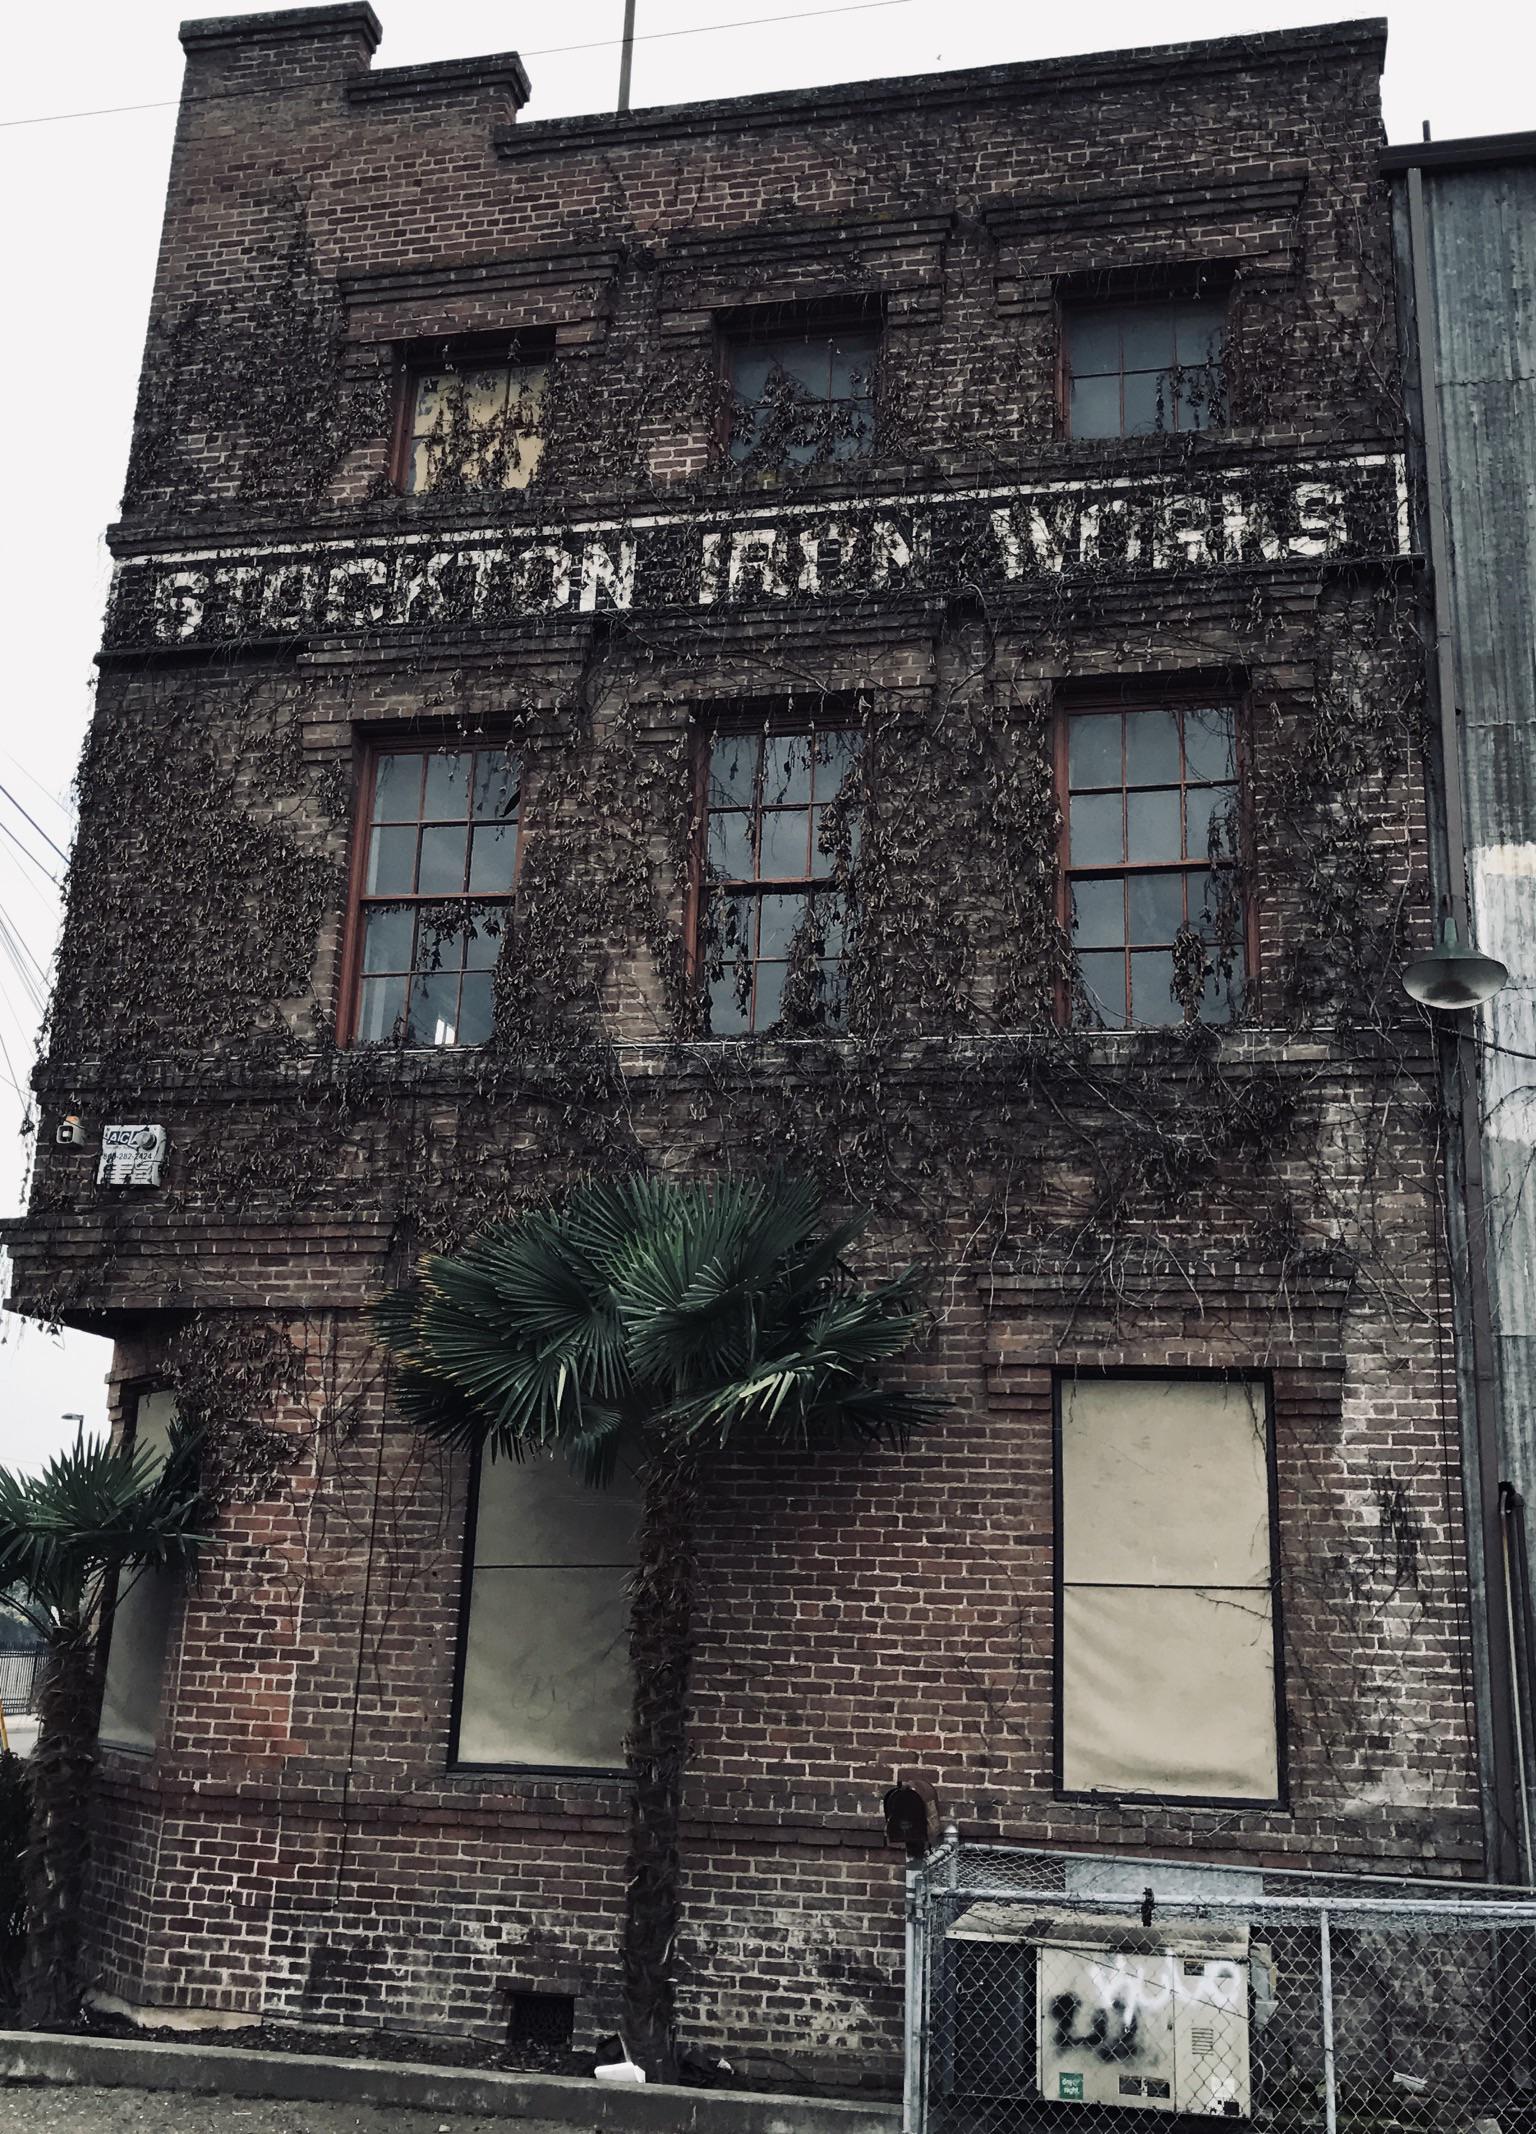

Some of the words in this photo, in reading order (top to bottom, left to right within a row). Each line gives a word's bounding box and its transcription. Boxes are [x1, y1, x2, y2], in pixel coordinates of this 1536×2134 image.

[154, 541, 638, 637] STOCKTON
[699, 516, 932, 604] IRON
[990, 483, 1348, 579] WORKS
